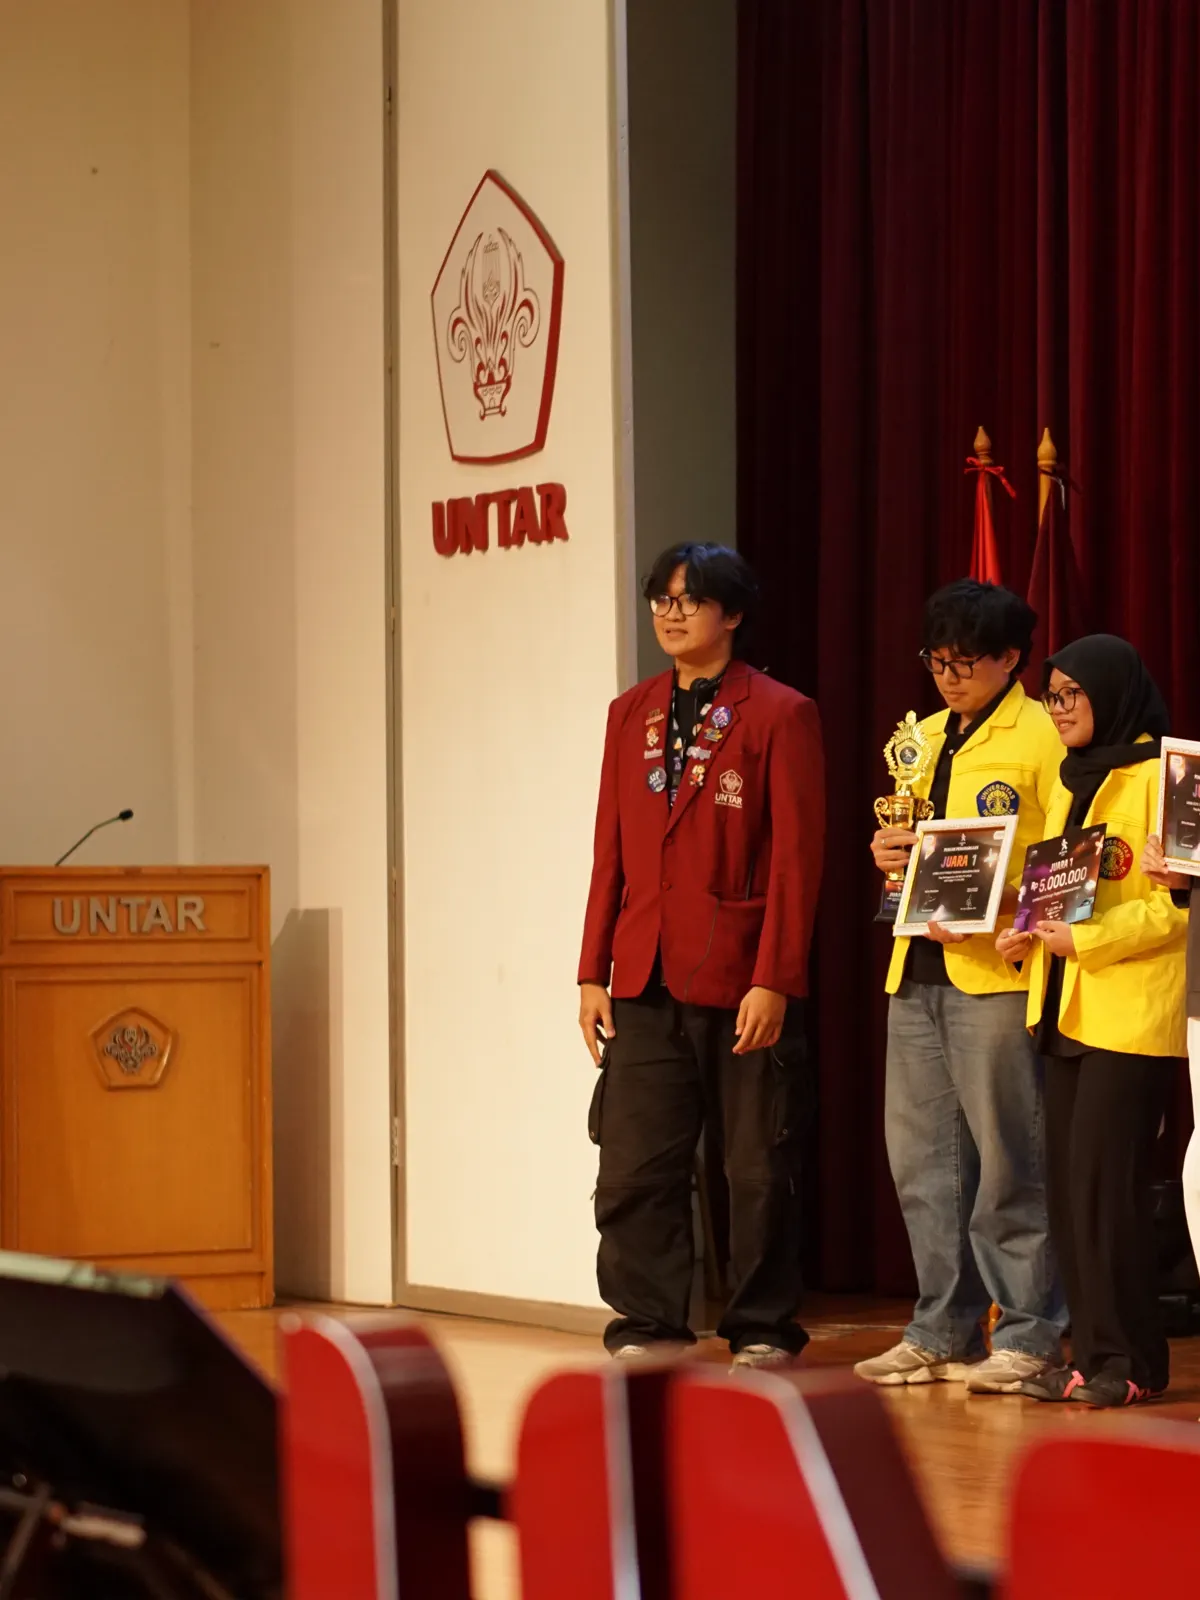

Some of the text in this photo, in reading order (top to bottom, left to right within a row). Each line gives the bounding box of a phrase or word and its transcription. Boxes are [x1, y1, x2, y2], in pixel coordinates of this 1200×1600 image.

[431, 482, 569, 559] UNTAR
[715, 792, 743, 806] UNTAR
[981, 783, 1016, 800] UNIVERSITAS
[941, 854, 968, 868] JUARA
[1049, 859, 1069, 873] JUARA
[1038, 866, 1088, 893] 5.000.000
[53, 895, 207, 935] UNTAR
